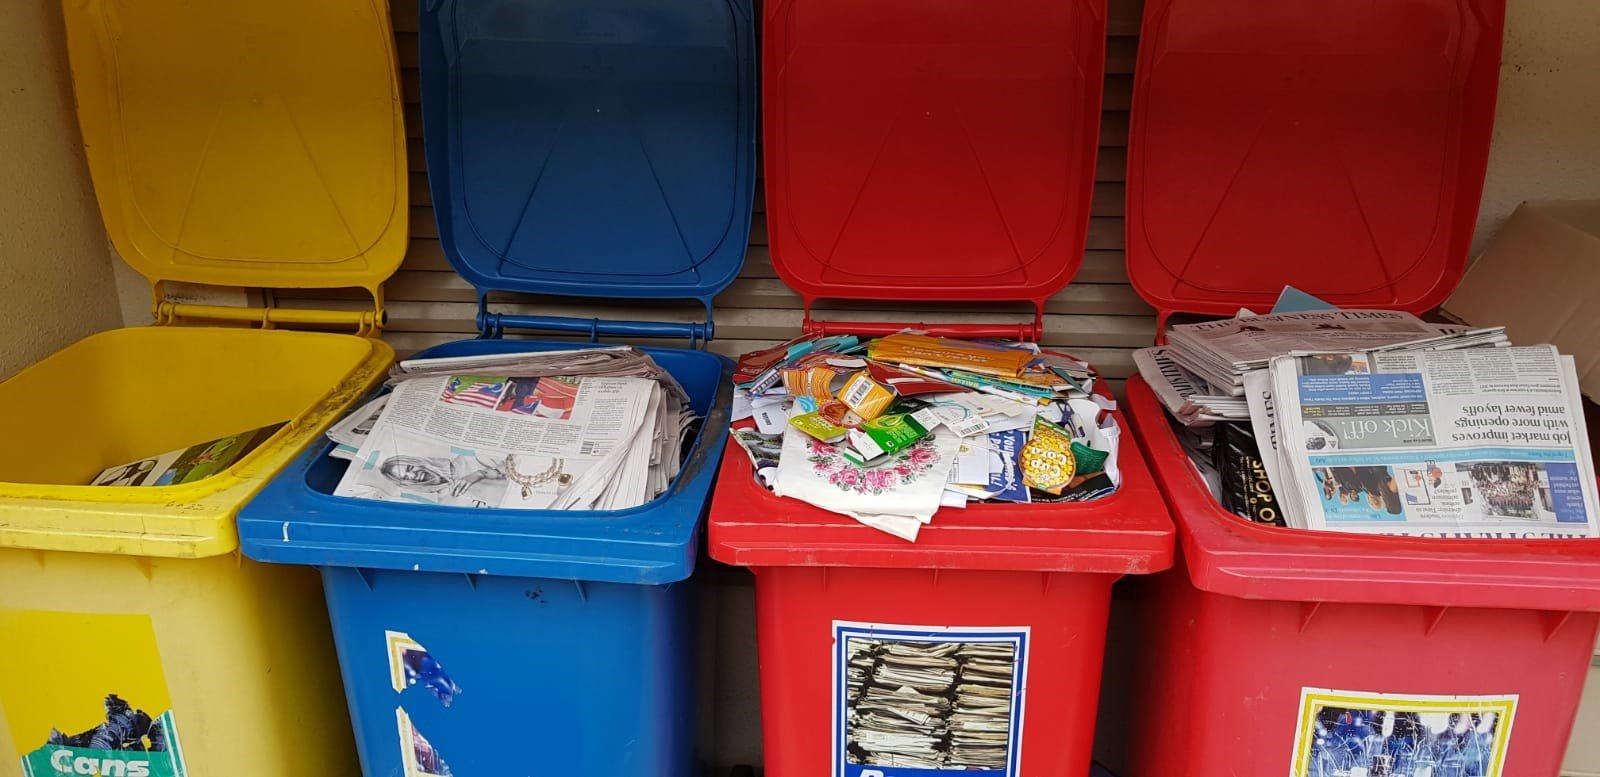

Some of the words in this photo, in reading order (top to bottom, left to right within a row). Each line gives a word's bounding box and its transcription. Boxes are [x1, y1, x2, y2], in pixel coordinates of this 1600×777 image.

[1239, 312, 1334, 323] BUSINESS
[1334, 311, 1403, 320] TIMES
[1462, 403, 1502, 417] layoffs
[1505, 405, 1535, 416] fewer
[1537, 405, 1565, 416] amid
[1341, 419, 1378, 440] off!
[1383, 419, 1431, 439] Kick
[1454, 416, 1509, 430] openings
[1512, 418, 1540, 428] more
[1543, 419, 1569, 431] with
[1451, 429, 1508, 443] improves
[1511, 432, 1550, 443] market
[1552, 430, 1572, 444] Job
[1252, 459, 1272, 503] SHOP
[51, 749, 149, 777] Cans
